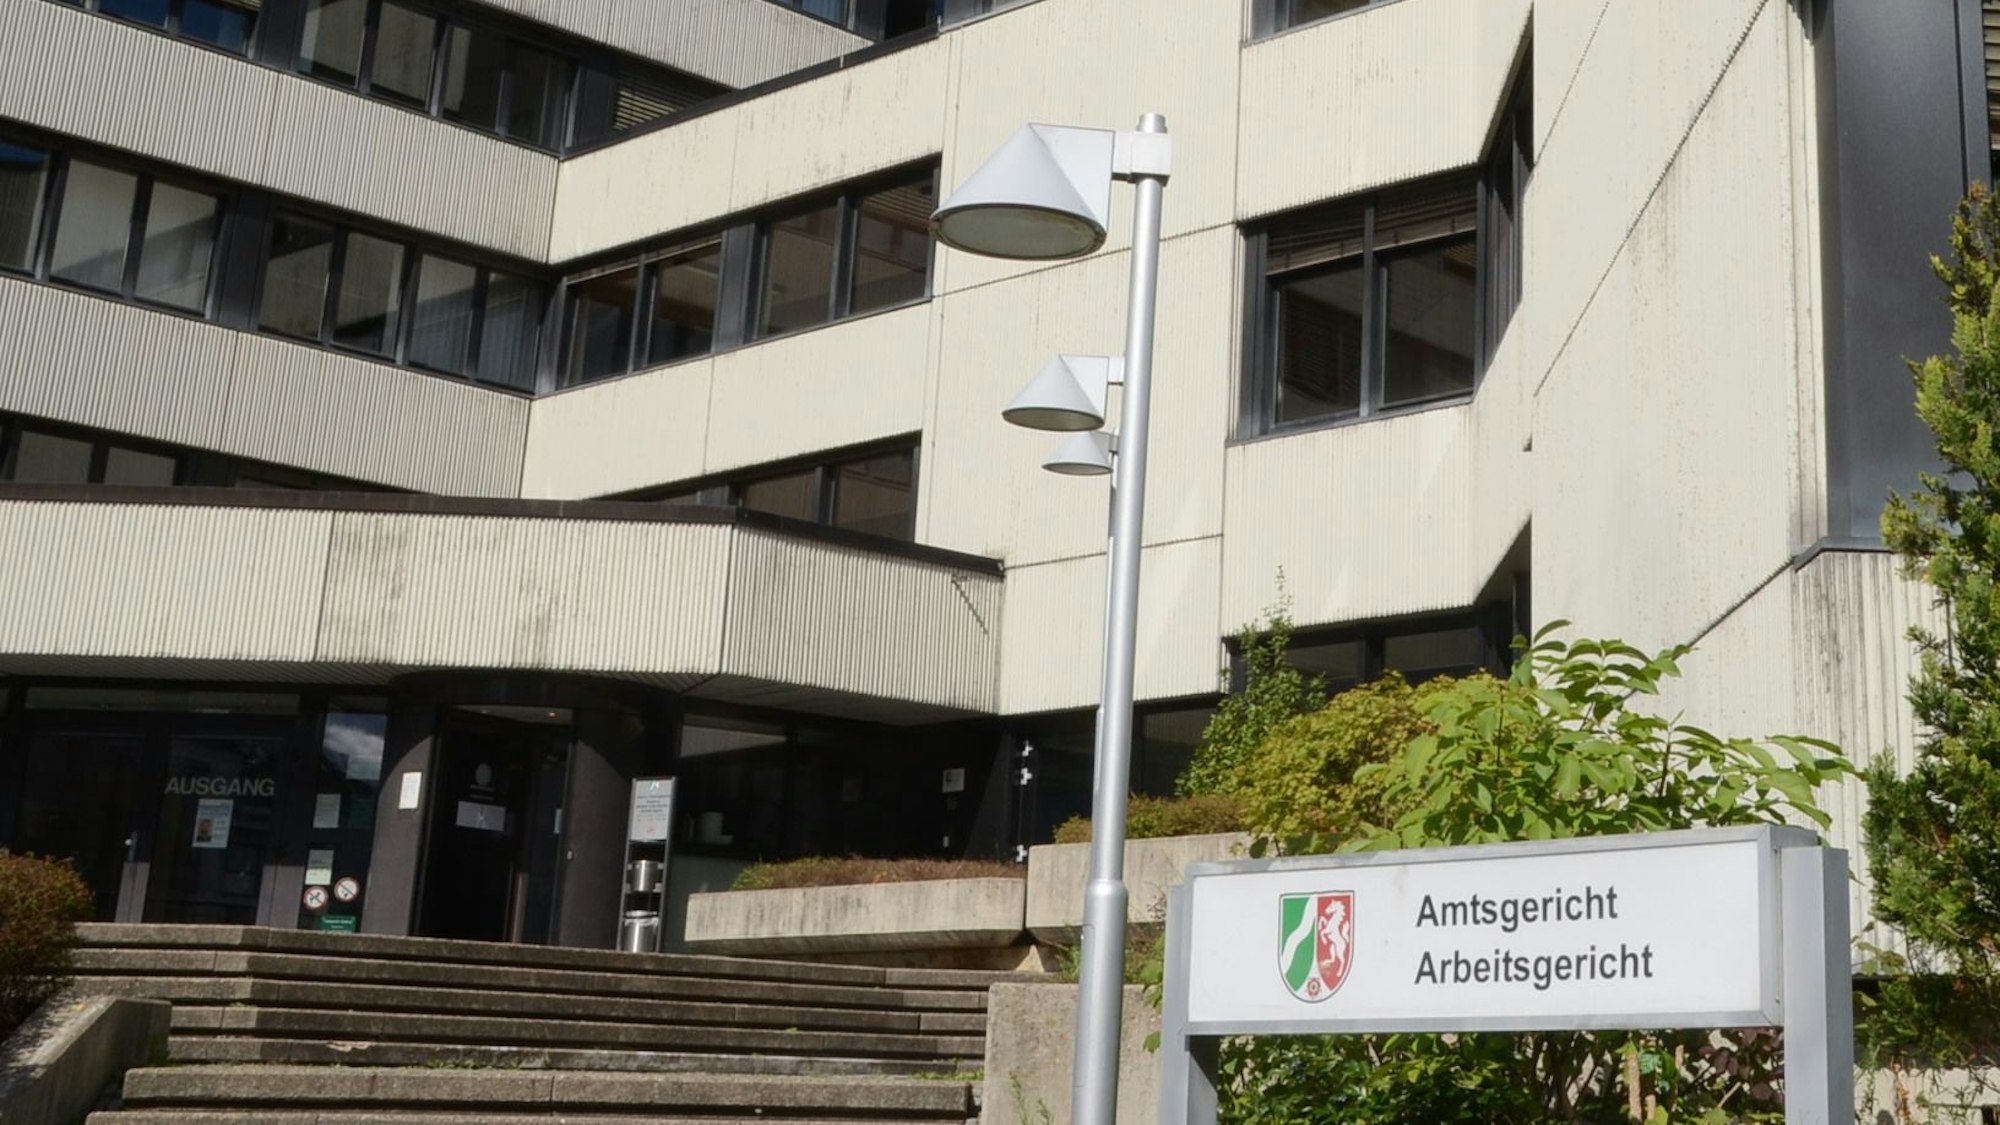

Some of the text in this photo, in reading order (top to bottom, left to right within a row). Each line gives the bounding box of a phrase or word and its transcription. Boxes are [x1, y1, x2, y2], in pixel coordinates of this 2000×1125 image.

[164, 776, 275, 796] AUSGANG
[1416, 885, 1618, 933] Amtsgericht
[1414, 943, 1653, 991] Arbeitsgericht
